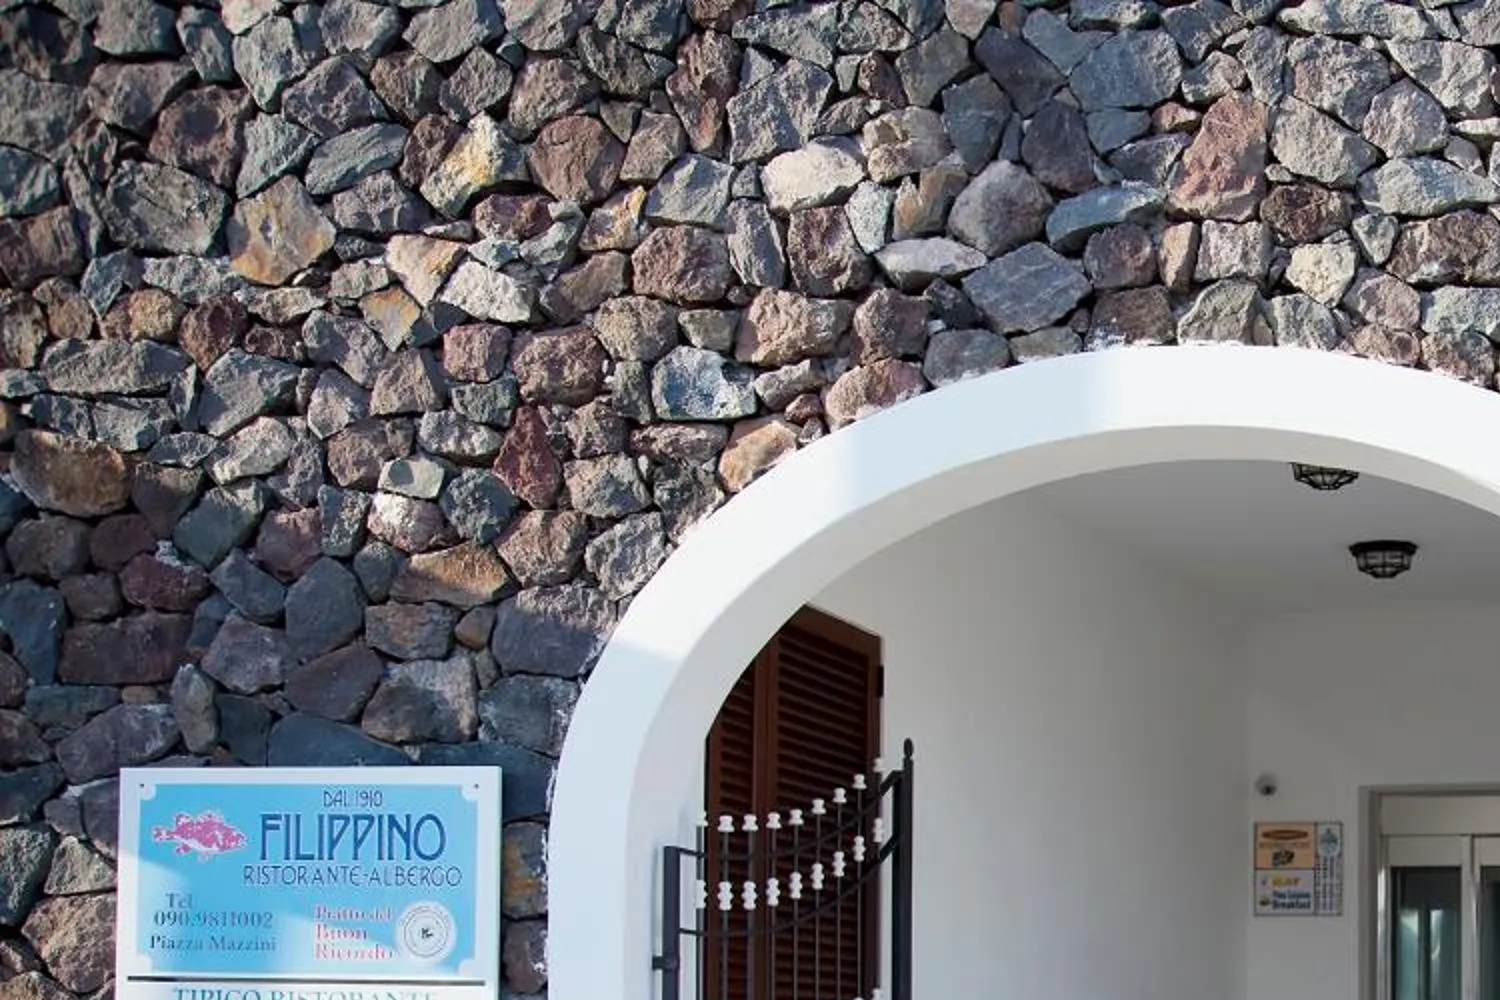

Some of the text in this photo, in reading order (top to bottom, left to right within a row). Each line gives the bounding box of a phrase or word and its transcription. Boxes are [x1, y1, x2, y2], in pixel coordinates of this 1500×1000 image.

[323, 789, 383, 808] DAL 1910
[259, 812, 448, 861] FILIPPINO
[242, 865, 463, 888] RISTORANTE-ALBERGO
[153, 910, 274, 929] 090.9811002
[150, 934, 278, 952] Piazza Mazzini
